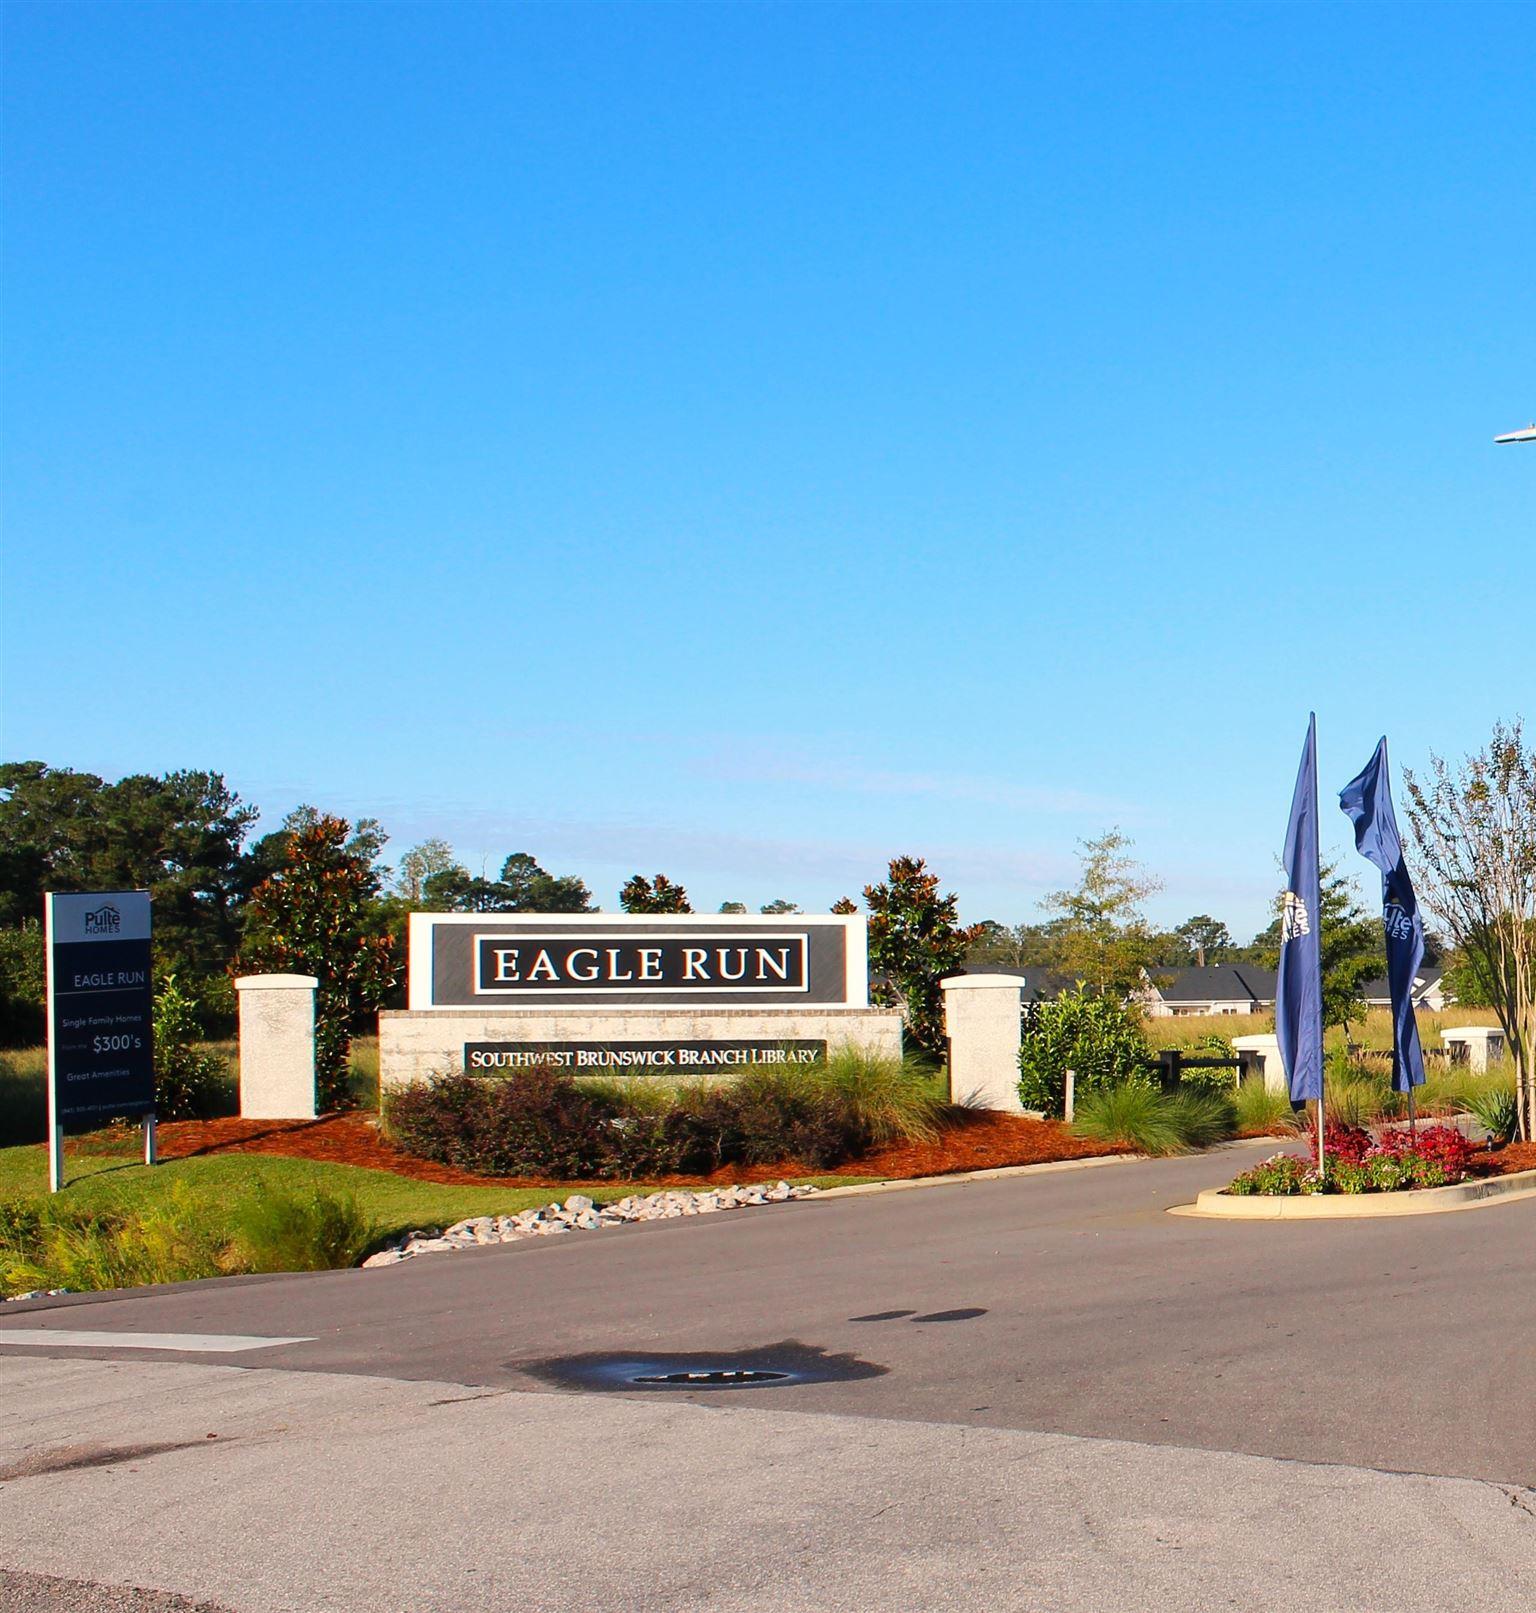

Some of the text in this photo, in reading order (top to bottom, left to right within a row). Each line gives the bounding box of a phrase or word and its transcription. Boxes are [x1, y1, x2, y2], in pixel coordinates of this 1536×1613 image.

[84, 909, 121, 927] Pulte
[85, 925, 121, 935] HOMES
[493, 947, 790, 982] EAGLE RUN
[74, 971, 145, 987] EAGLE RUN
[62, 1014, 142, 1029] Single Family Homes
[93, 1034, 142, 1054] $300's
[471, 1048, 818, 1068] SOUTHWEST BRUNSWICK BRANCH LIBRARY
[66, 1068, 131, 1081] Great Amenities
